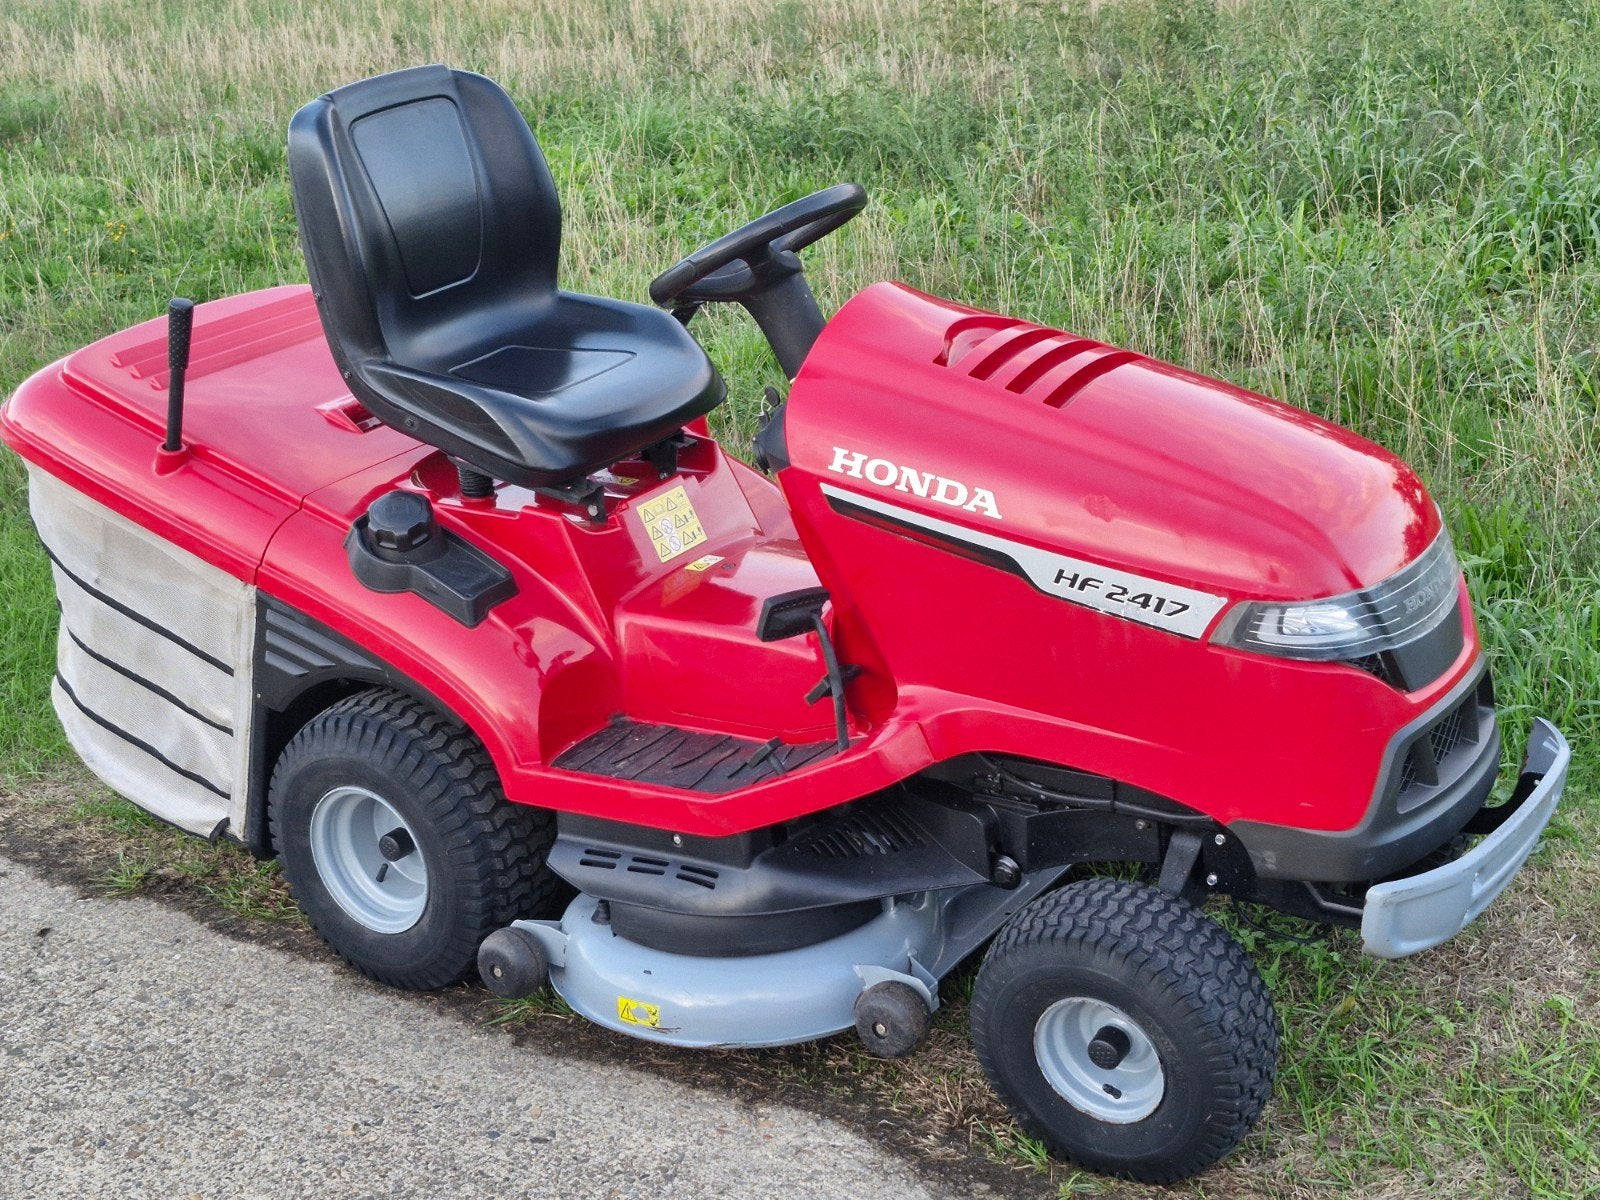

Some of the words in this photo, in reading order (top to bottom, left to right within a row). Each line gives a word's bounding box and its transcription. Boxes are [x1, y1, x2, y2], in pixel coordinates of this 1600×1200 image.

[828, 446, 1003, 519] HONDA
[1053, 568, 1104, 593] HF
[1105, 585, 1190, 617] 2417
